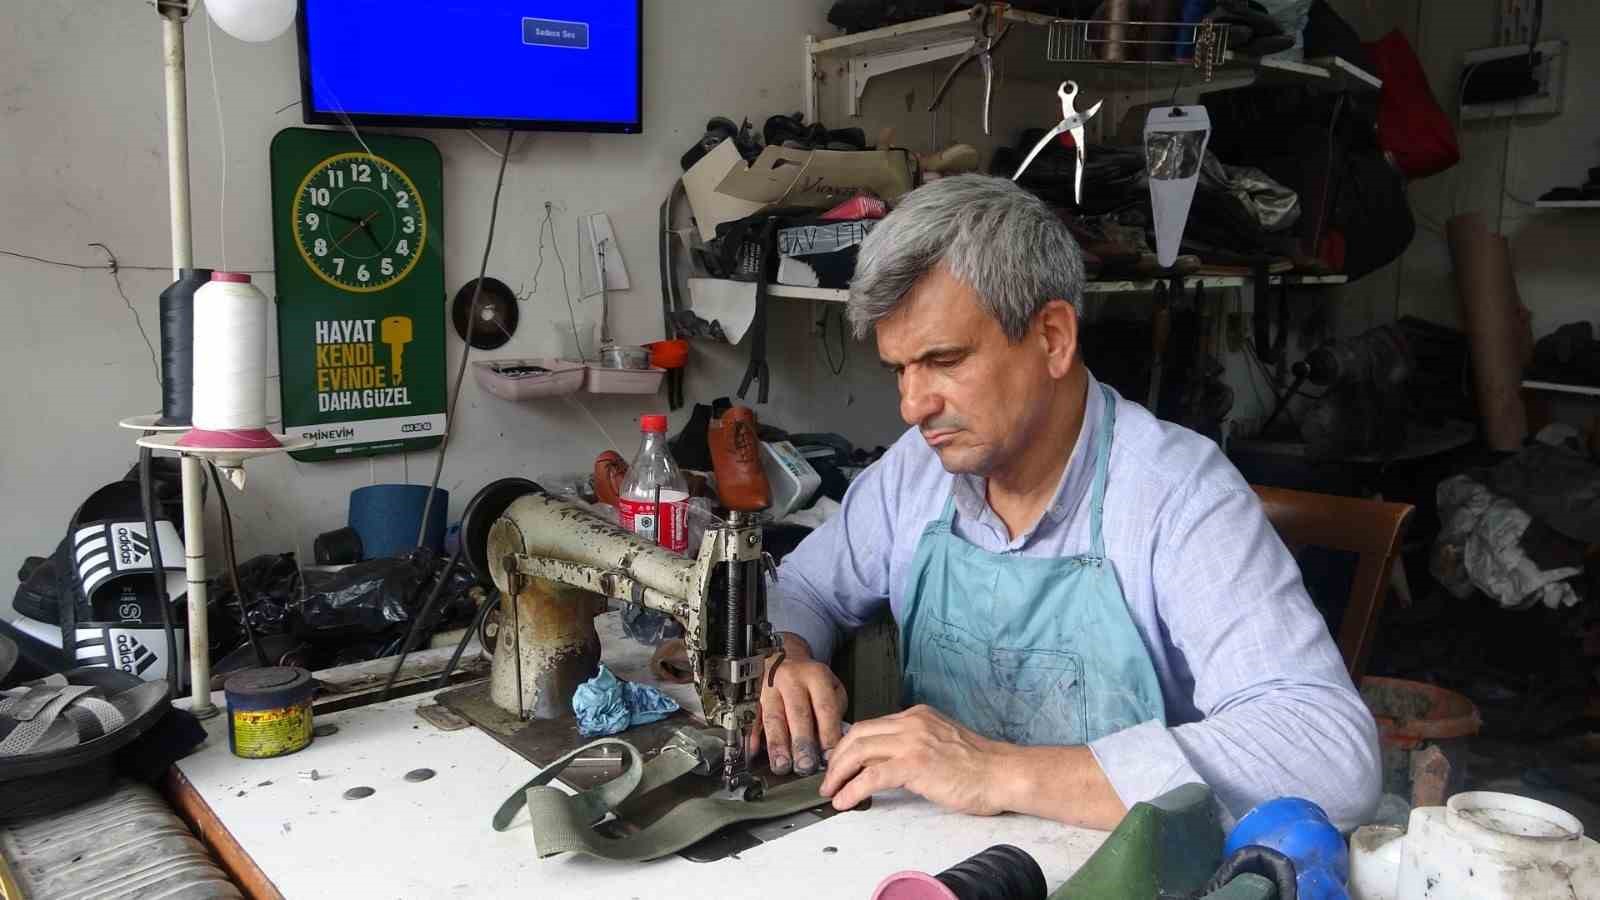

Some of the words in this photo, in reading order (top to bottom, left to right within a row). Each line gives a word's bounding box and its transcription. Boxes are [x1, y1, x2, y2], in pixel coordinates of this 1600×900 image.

[328, 169, 343, 188] 11
[350, 163, 371, 182] 12
[381, 172, 388, 190] 1
[309, 187, 330, 206] 10
[396, 191, 409, 208] 2
[305, 213, 319, 231] 9
[402, 216, 415, 233] 3
[314, 238, 328, 256] 8
[395, 239, 409, 256] 4
[332, 258, 345, 275] 7
[357, 264, 370, 281] 6
[381, 258, 394, 275] 5
[315, 319, 376, 344] HAYAT
[316, 343, 374, 368] KENDİ
[317, 366, 386, 392] EVİNDE
[318, 390, 361, 412] DAHA
[363, 387, 412, 408] GÜZEL
[118, 527, 132, 565] adidas
[116, 634, 134, 673] adida
